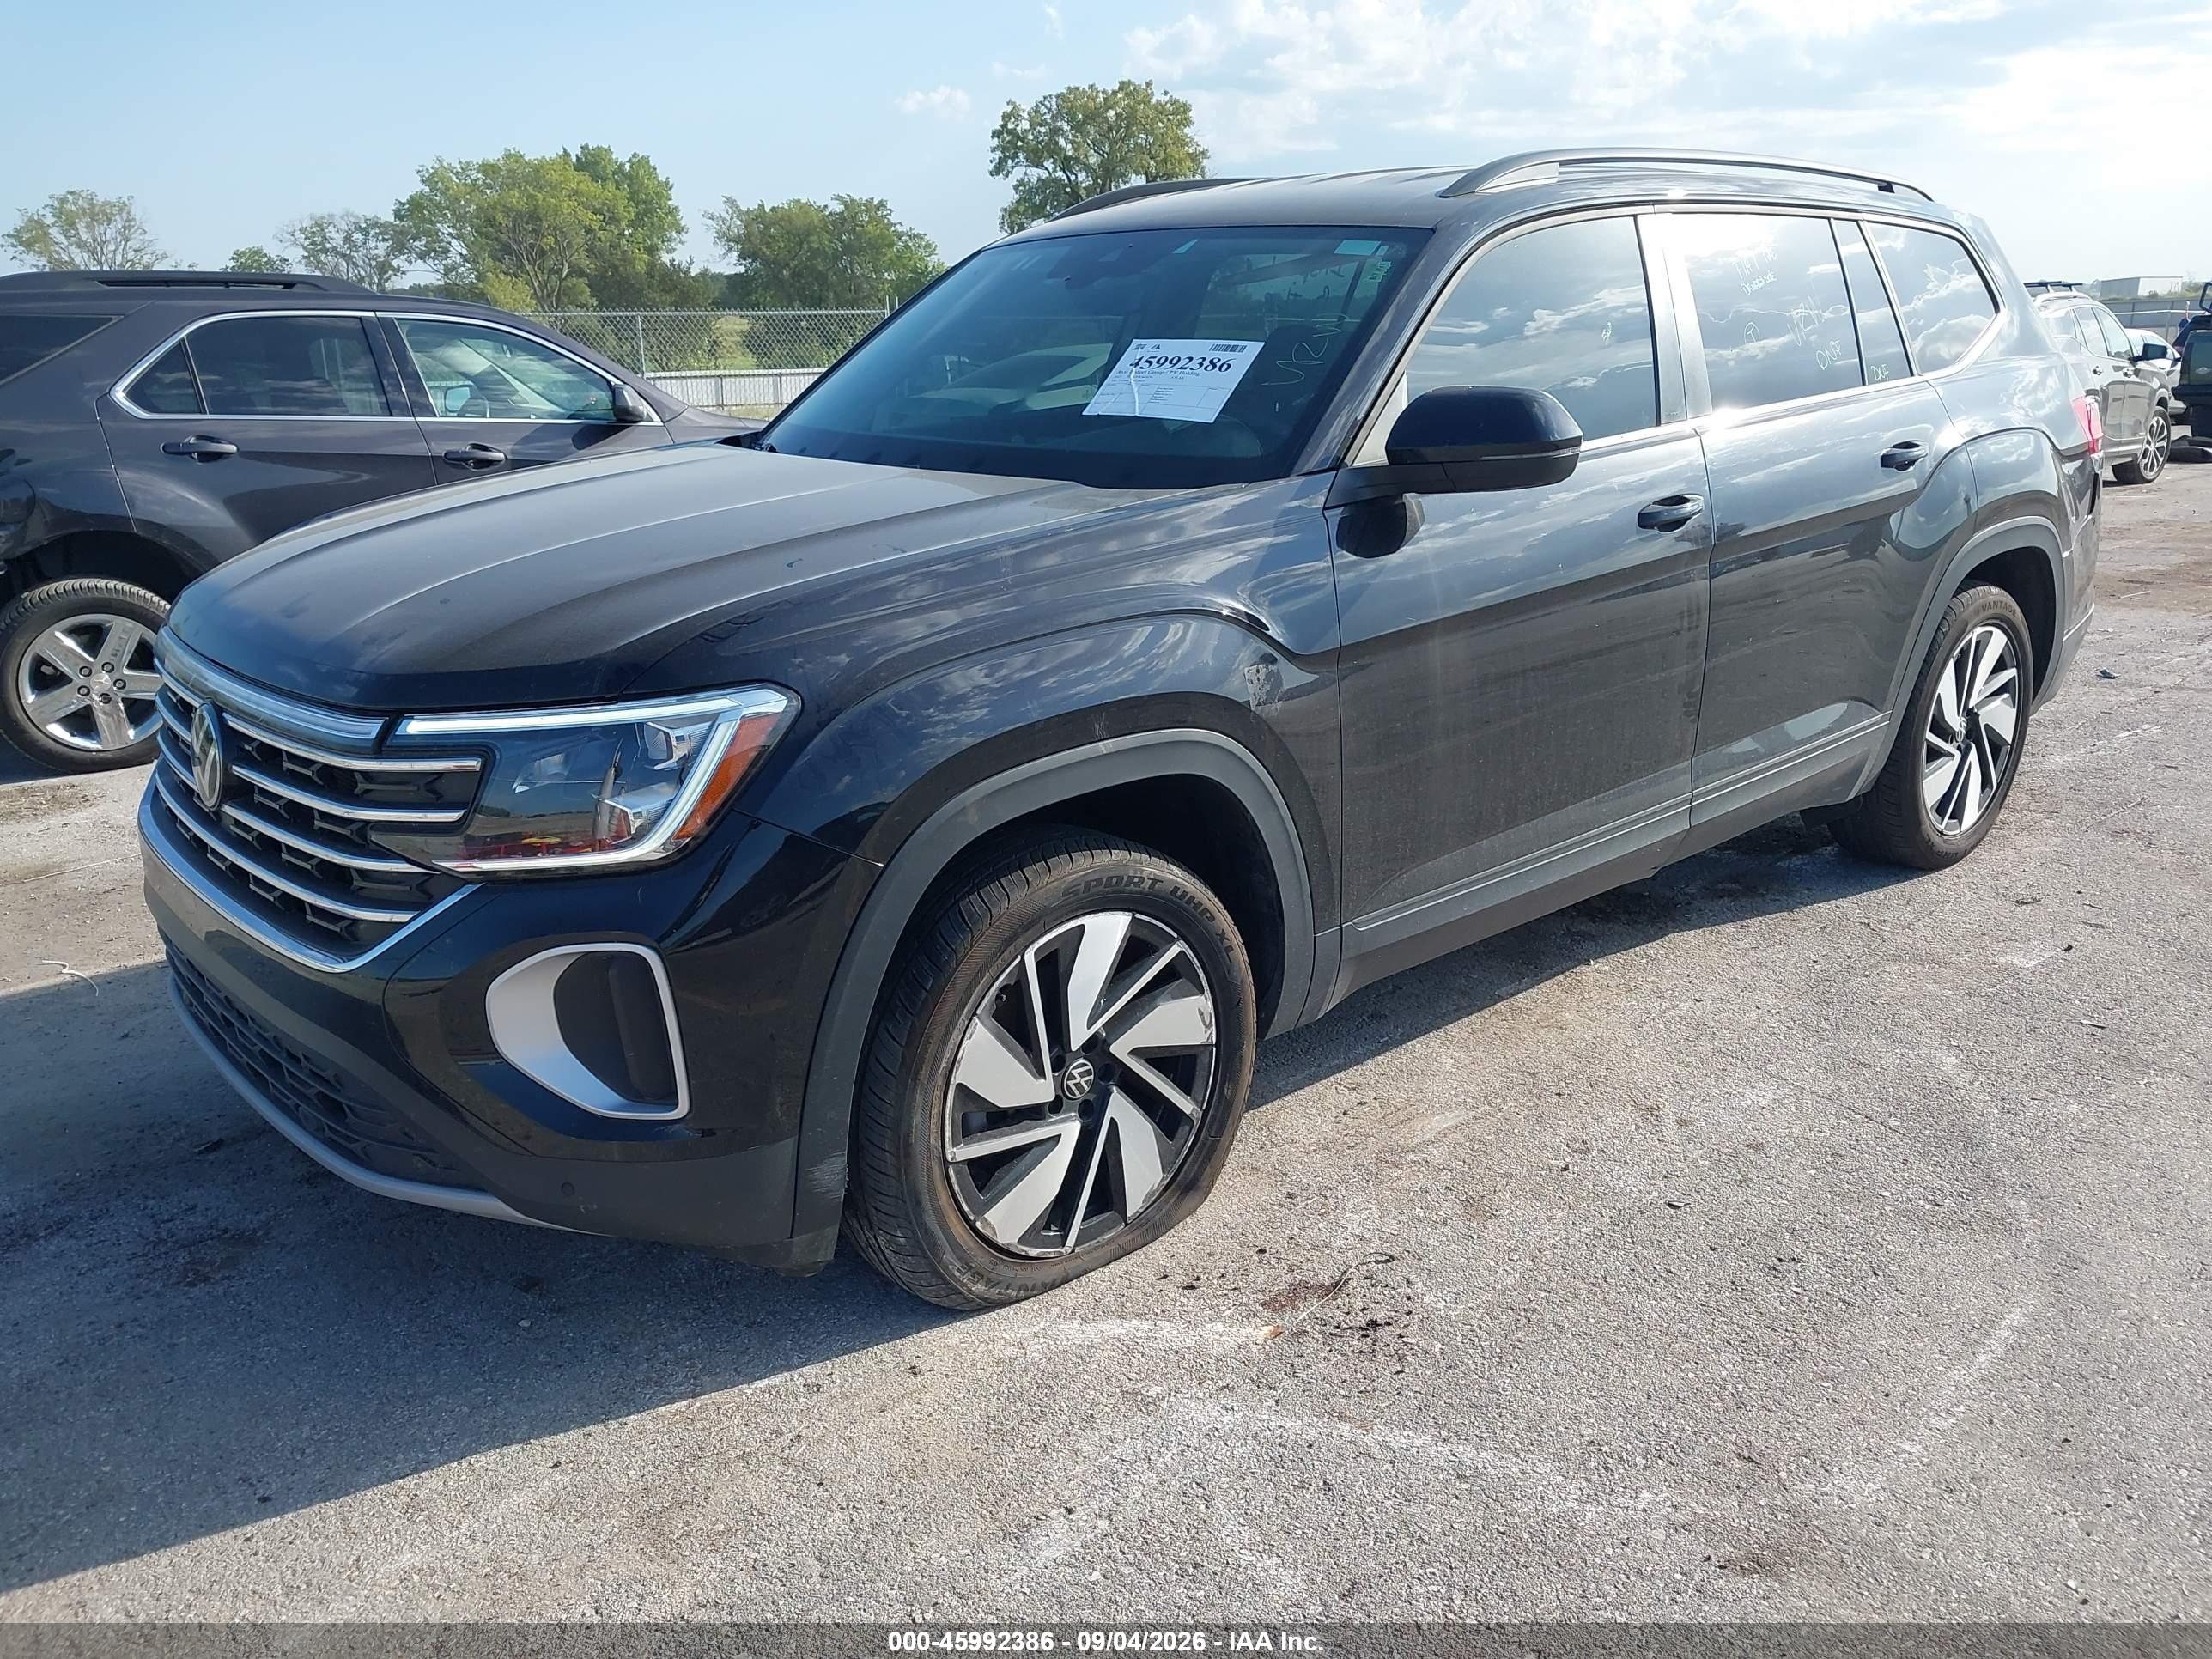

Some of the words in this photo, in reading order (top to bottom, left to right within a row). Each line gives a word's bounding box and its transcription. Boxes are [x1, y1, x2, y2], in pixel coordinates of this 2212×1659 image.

[1129, 356, 1237, 372] 45992386
[1061, 875, 1164, 897] SPORT
[1169, 885, 1216, 924] UHP
[1215, 928, 1235, 963] XL
